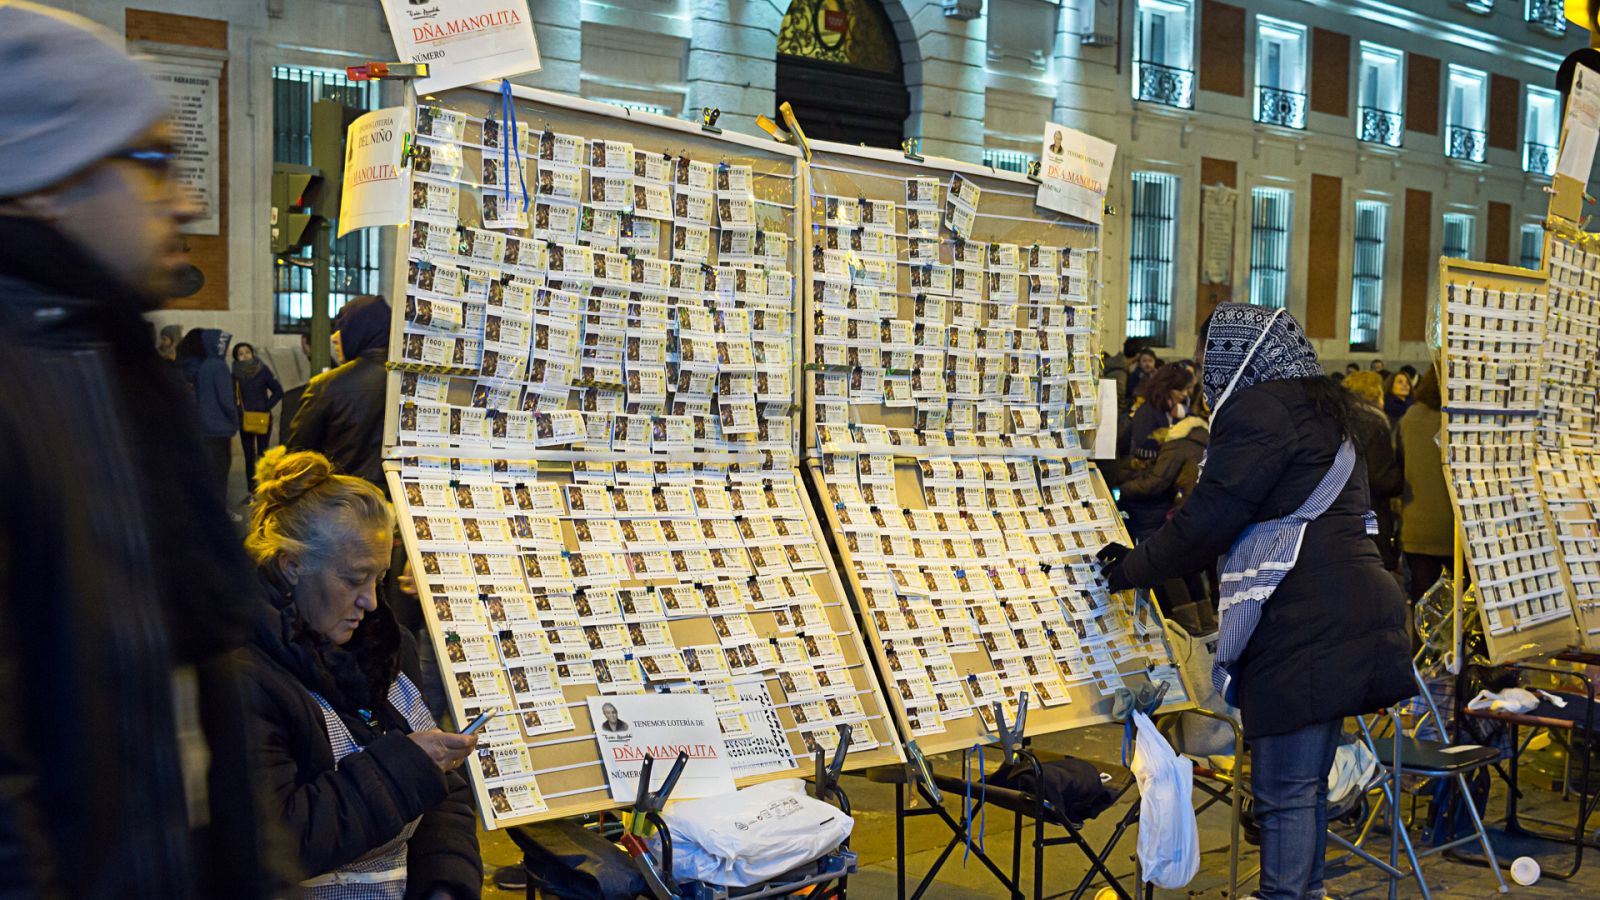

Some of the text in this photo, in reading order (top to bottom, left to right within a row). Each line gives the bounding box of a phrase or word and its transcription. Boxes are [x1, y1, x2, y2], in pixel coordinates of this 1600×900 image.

[411, 50, 446, 63] NÚMERO
[370, 128, 393, 145] NIÑO
[633, 720, 667, 728] TENEMOS
[667, 717, 695, 728] LOTERÍA
[647, 744, 717, 758] MANOLITA
